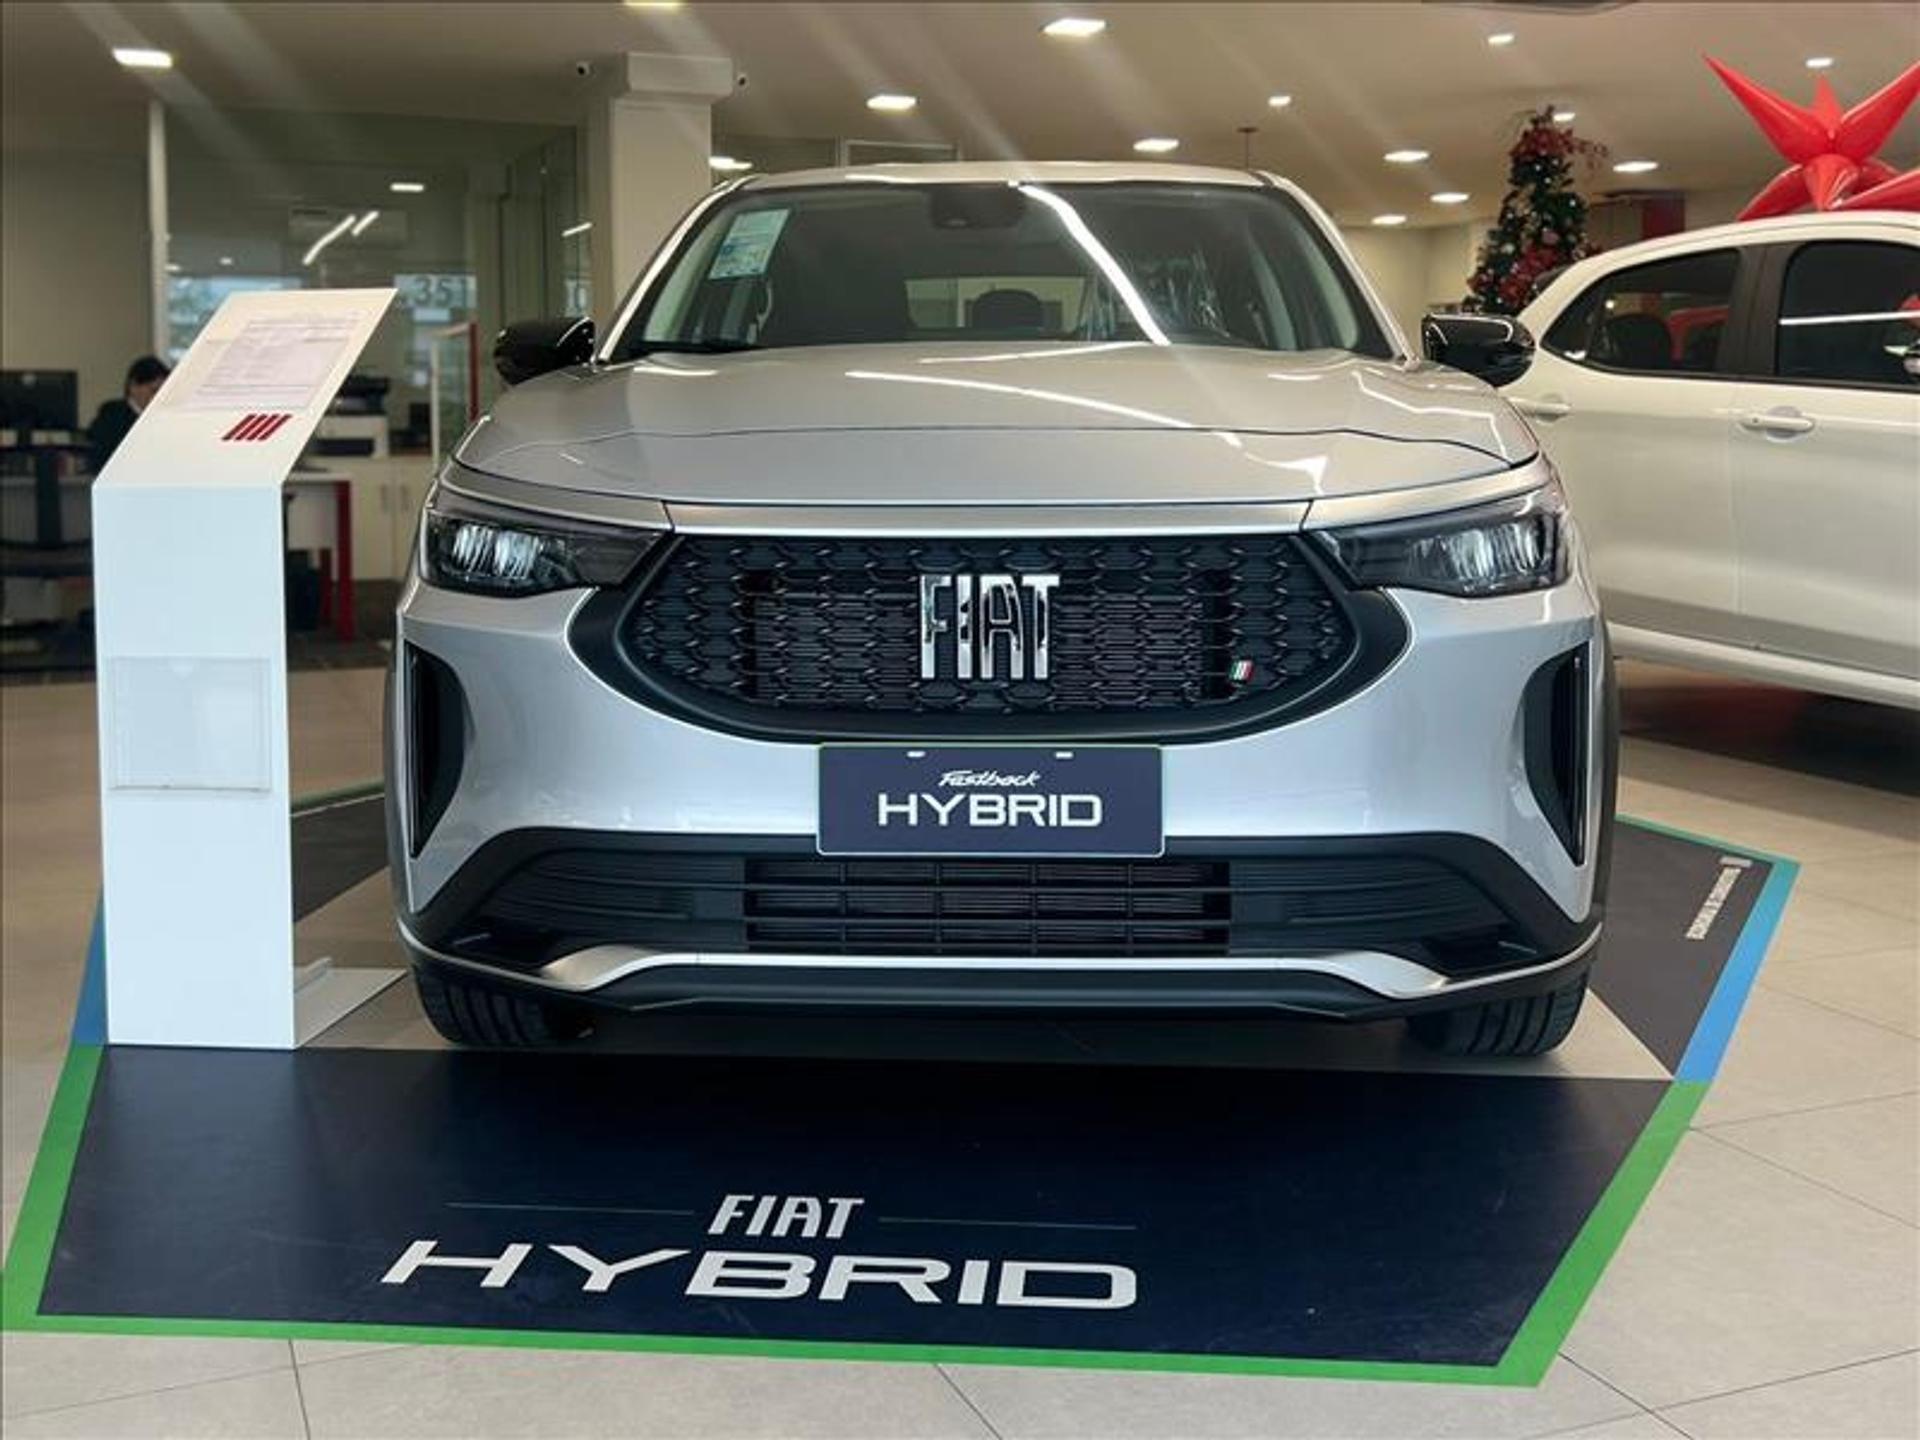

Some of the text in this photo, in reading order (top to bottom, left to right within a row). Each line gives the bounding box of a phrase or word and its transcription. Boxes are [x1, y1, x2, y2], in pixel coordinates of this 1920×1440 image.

[920, 574, 1060, 679] FIAT
[878, 793, 1103, 827] HYBRID
[707, 1193, 866, 1239] FIAT
[380, 1240, 1139, 1310] HYBRID
